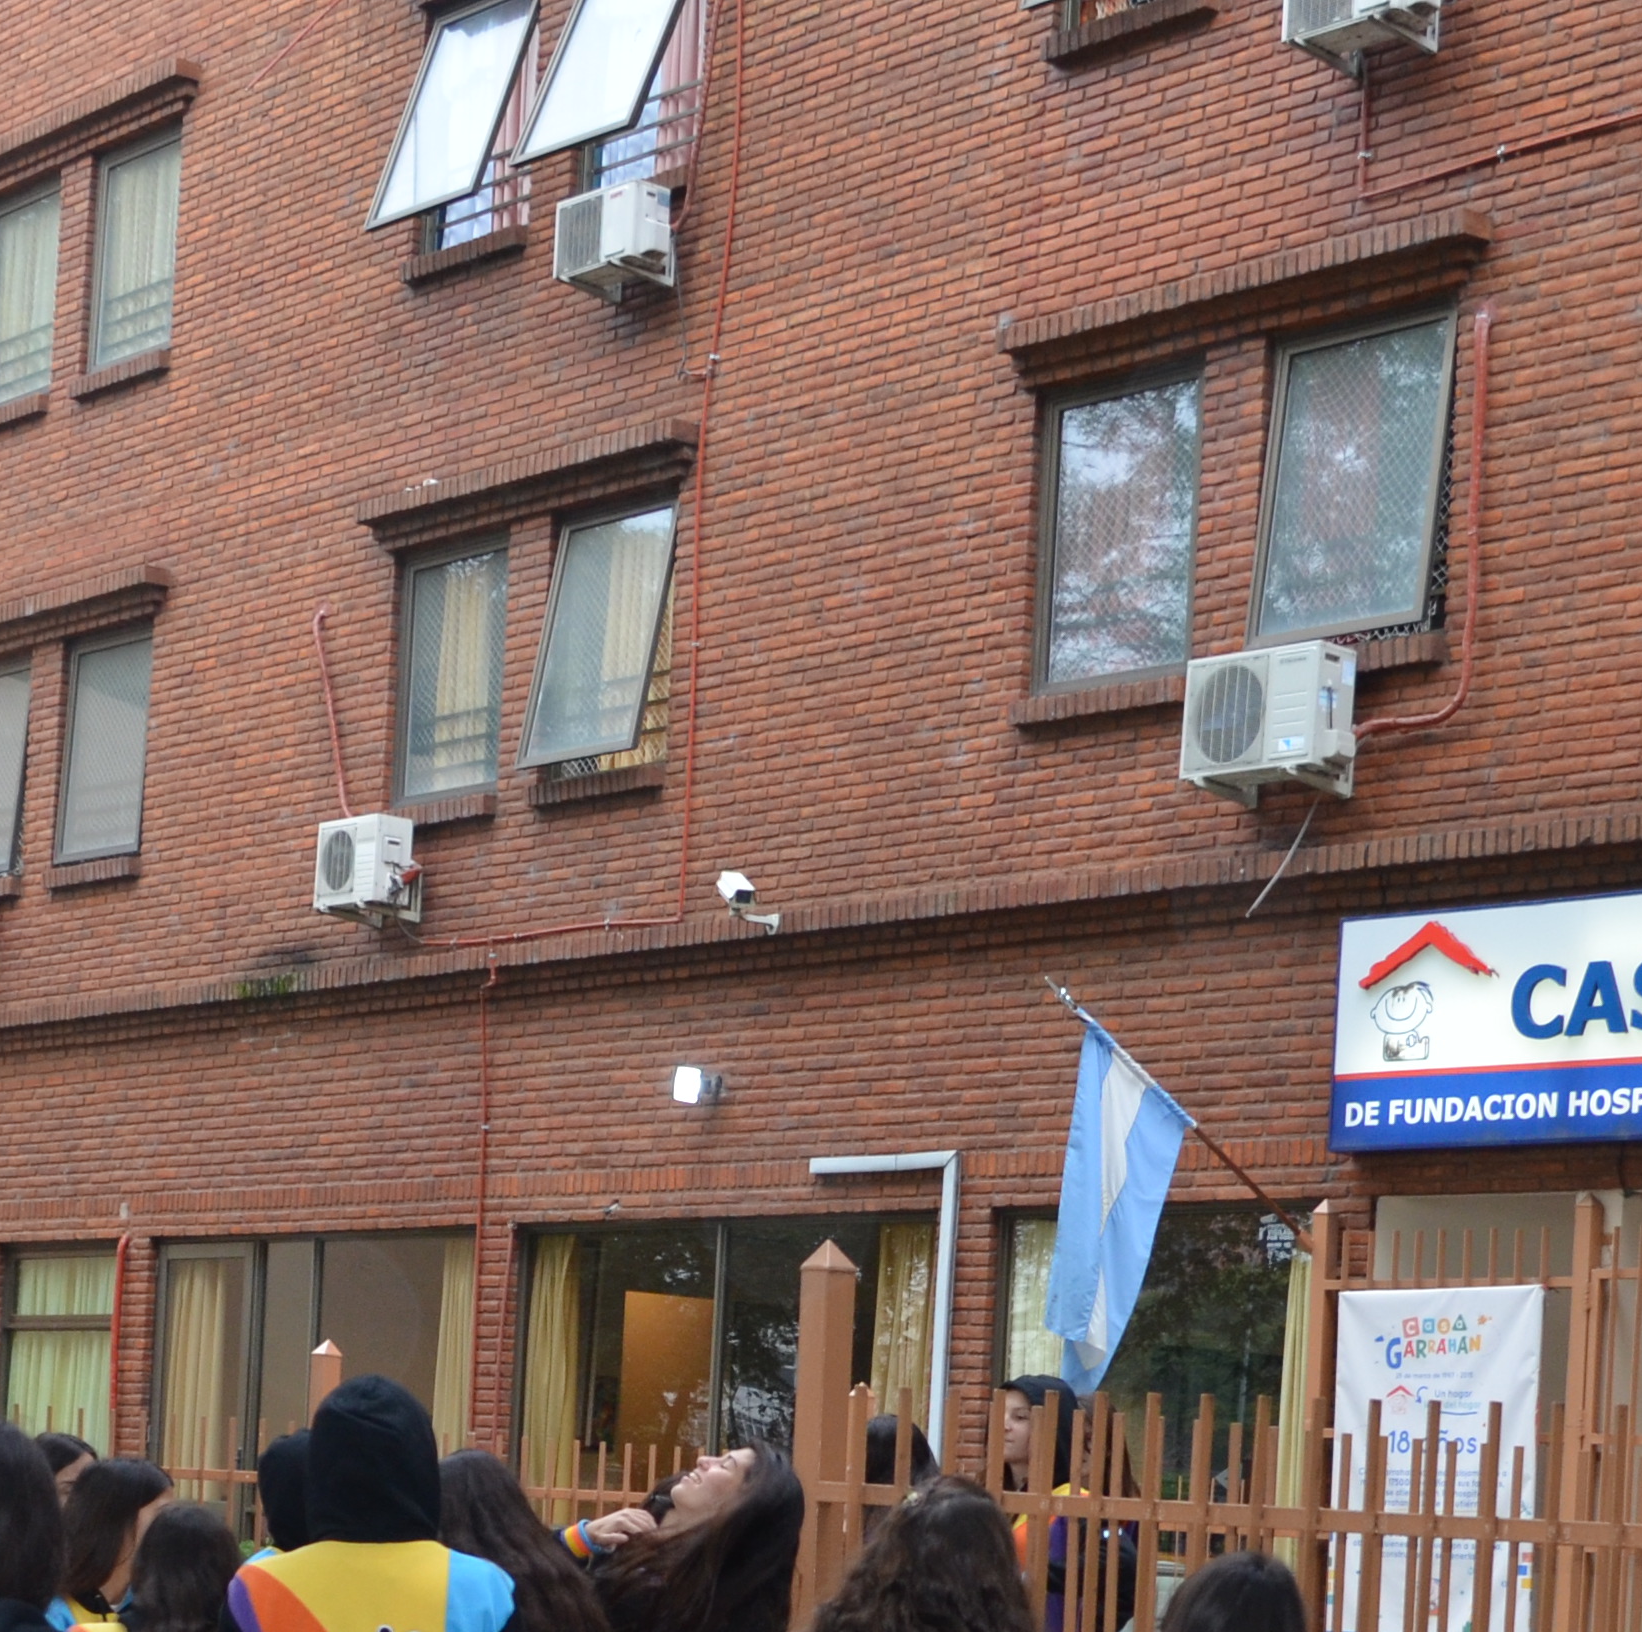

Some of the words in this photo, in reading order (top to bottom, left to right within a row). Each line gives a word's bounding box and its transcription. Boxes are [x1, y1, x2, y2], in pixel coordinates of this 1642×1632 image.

[1344, 1101, 1380, 1127] DE
[1388, 1092, 1558, 1125] FUNDACION
[1385, 1334, 1482, 1369] GARRAHAN
[1434, 1389, 1446, 1397] Un
[1448, 1389, 1473, 1399] hogar
[1388, 1430, 1411, 1453] 18
